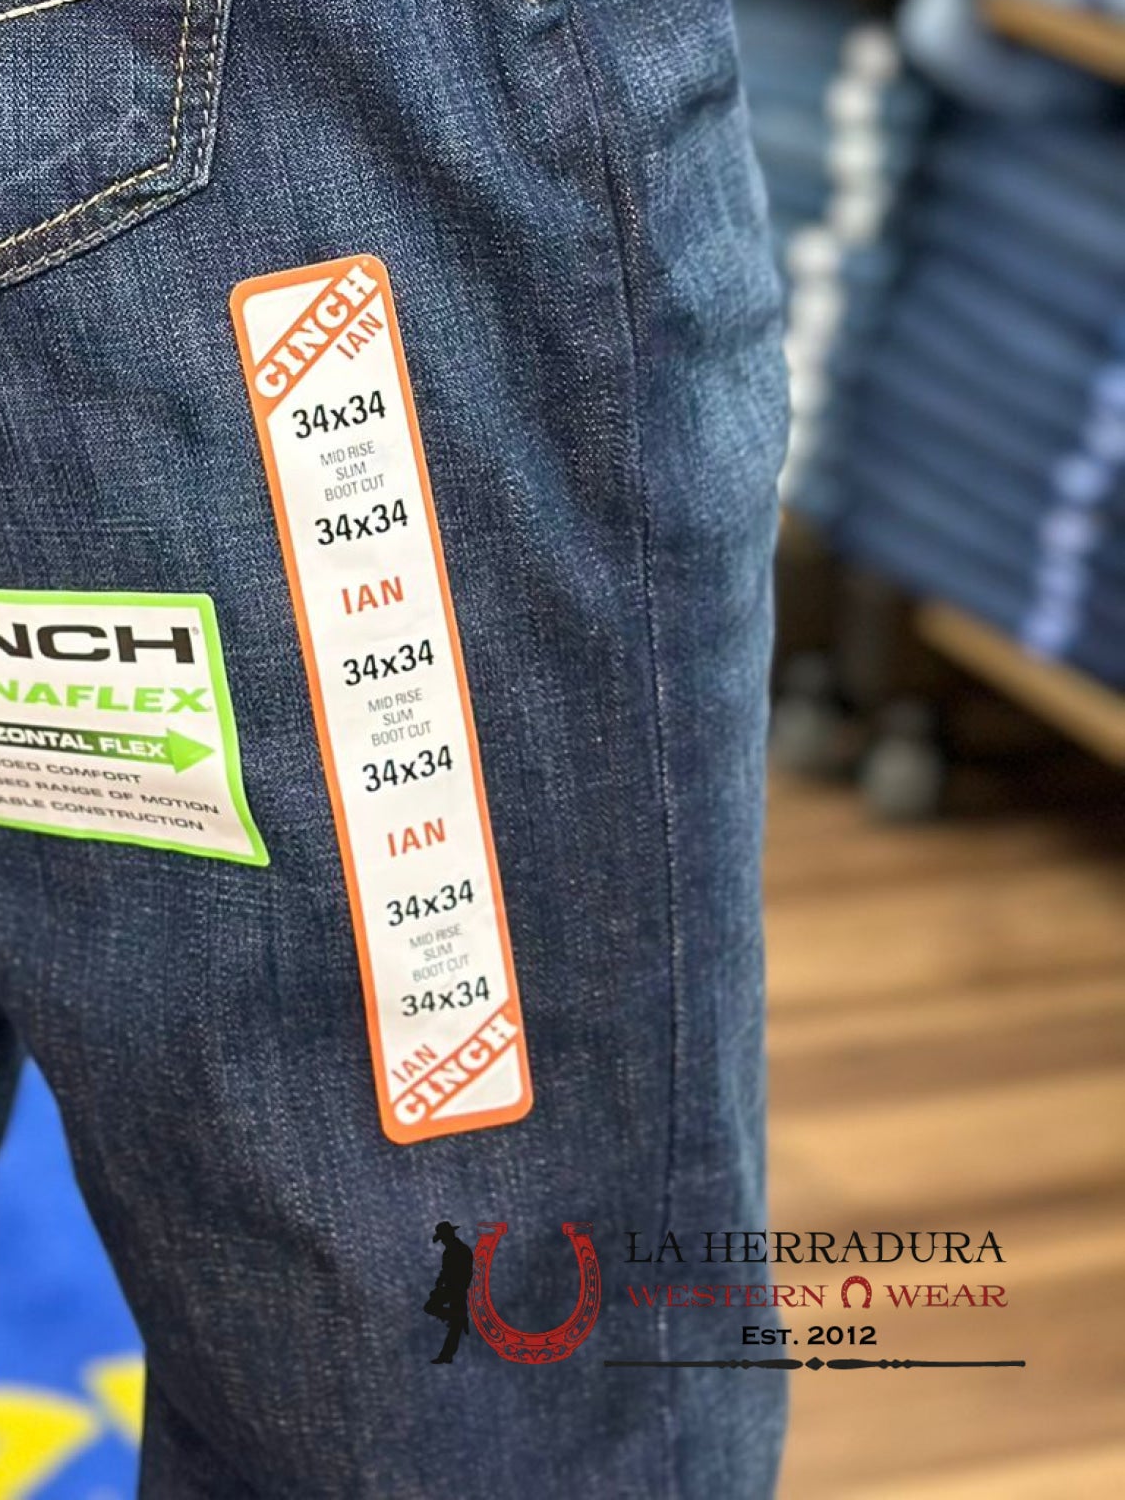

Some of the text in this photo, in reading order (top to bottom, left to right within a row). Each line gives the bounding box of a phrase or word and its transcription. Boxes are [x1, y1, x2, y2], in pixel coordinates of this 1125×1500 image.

[254, 264, 378, 398] CINCH
[336, 312, 384, 360] IAN
[292, 390, 386, 438] 34x34
[320, 441, 376, 466] MID RISE
[325, 473, 385, 501] BOOT CUT
[335, 461, 367, 481] SLIM
[315, 498, 409, 545] 34x34
[341, 576, 405, 615] IAN
[343, 639, 434, 686] 34x34
[368, 687, 423, 712] MID RISE
[371, 720, 431, 747] BOOT CUT
[382, 708, 414, 726] SLIM
[99, 735, 169, 760] FLEX
[47, 763, 142, 784] COMFORT
[362, 744, 453, 792] 34x34
[35, 781, 104, 798] RANGE
[108, 790, 133, 801] OF
[140, 794, 220, 814] MOTION
[51, 802, 204, 831] CONSTRUCTION
[387, 818, 446, 856] IAN
[386, 878, 474, 927] 34x34
[409, 923, 463, 948] MID RISE
[423, 942, 454, 962] SLIM
[412, 954, 469, 982] BOOT CUT
[401, 975, 490, 1017] 34x34
[391, 1043, 439, 1084] IAN
[394, 1014, 518, 1126] CINCH
